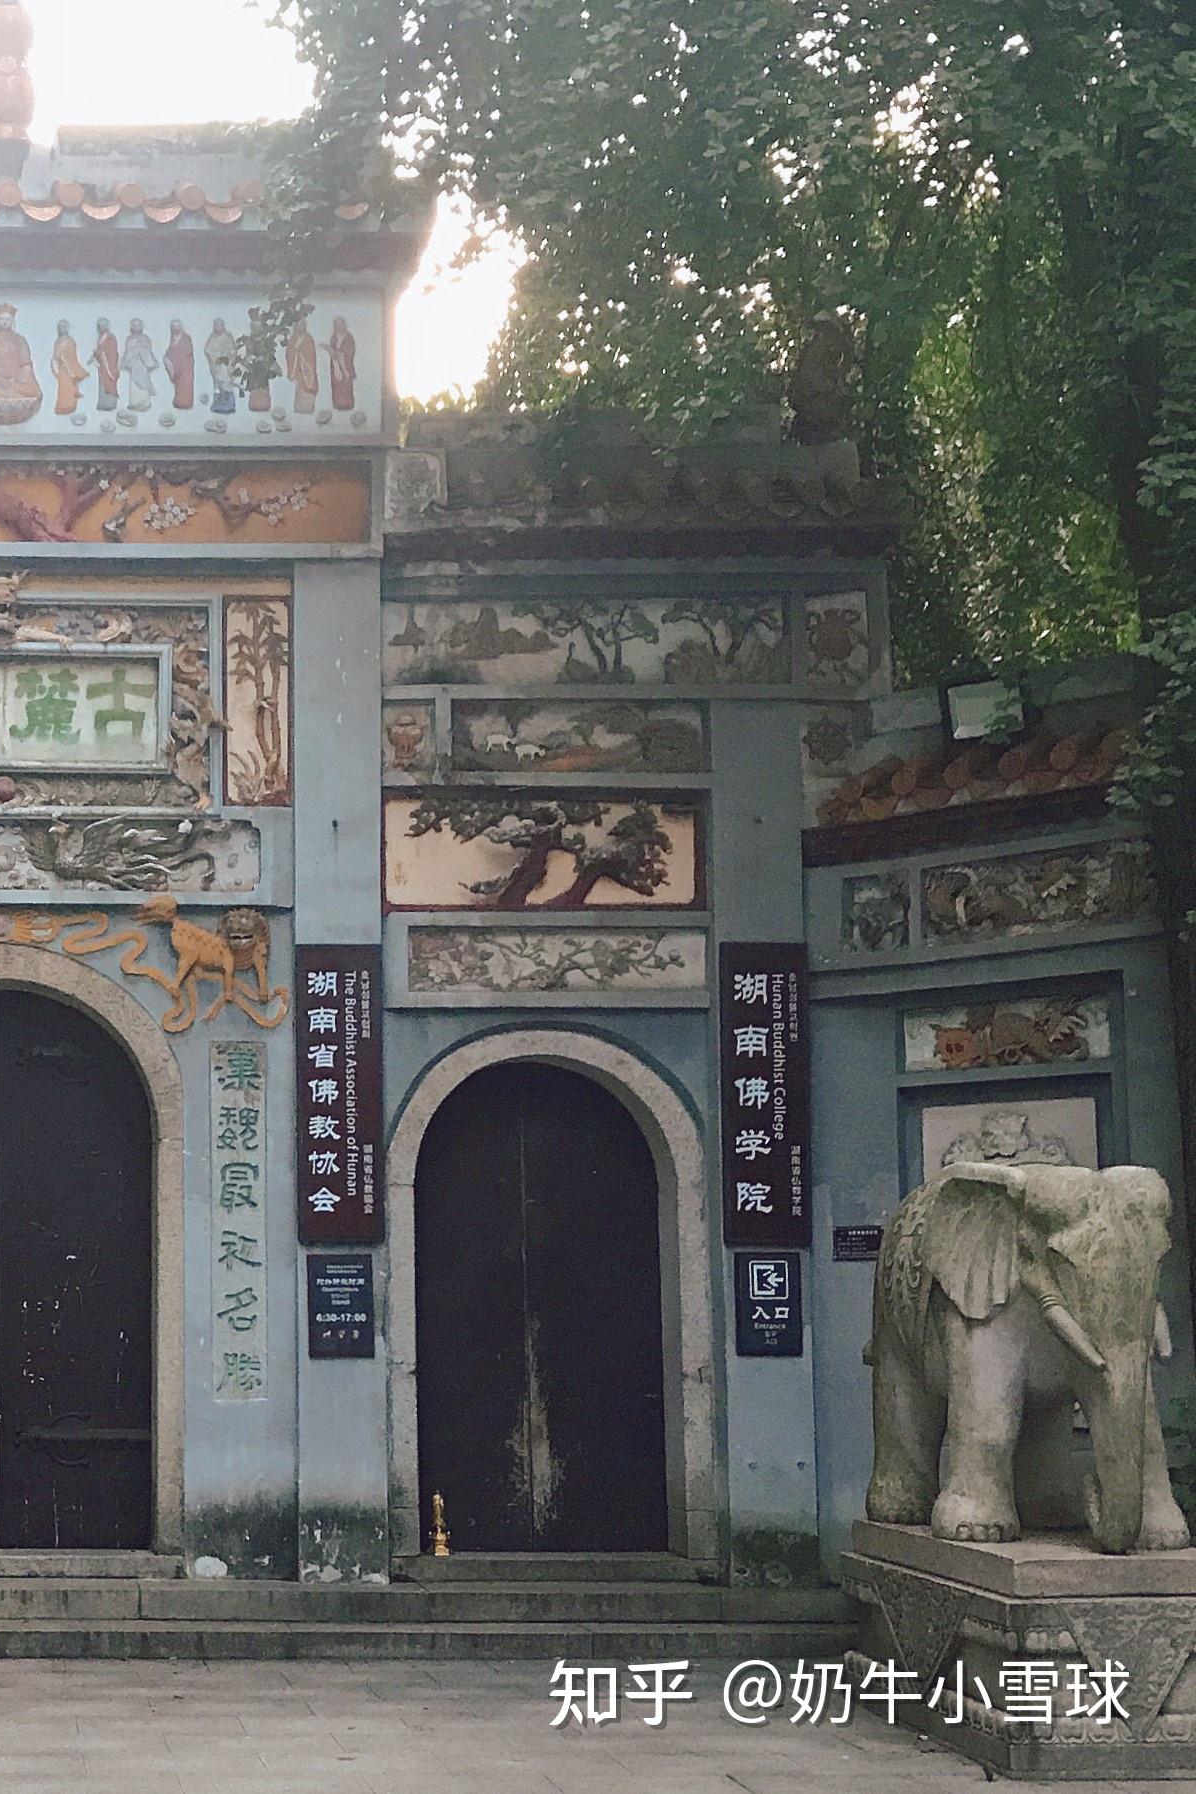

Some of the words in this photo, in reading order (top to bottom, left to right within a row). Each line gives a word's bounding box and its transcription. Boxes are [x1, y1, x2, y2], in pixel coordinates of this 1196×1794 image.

[345, 970, 357, 995] The
[772, 974, 784, 1019] Hunan
[345, 998, 358, 1056] Buddhist
[773, 1022, 786, 1084] Buddhist
[307, 970, 341, 1213] 湖南省佛教协会
[346, 1058, 358, 1134] Association
[733, 972, 773, 1214] 湖南佛学院
[772, 1087, 786, 1140] College
[347, 1136, 360, 1150] of
[347, 1153, 359, 1196] Hunan
[751, 1306, 790, 1320] 入口
[754, 1322, 786, 1330] Entrance
